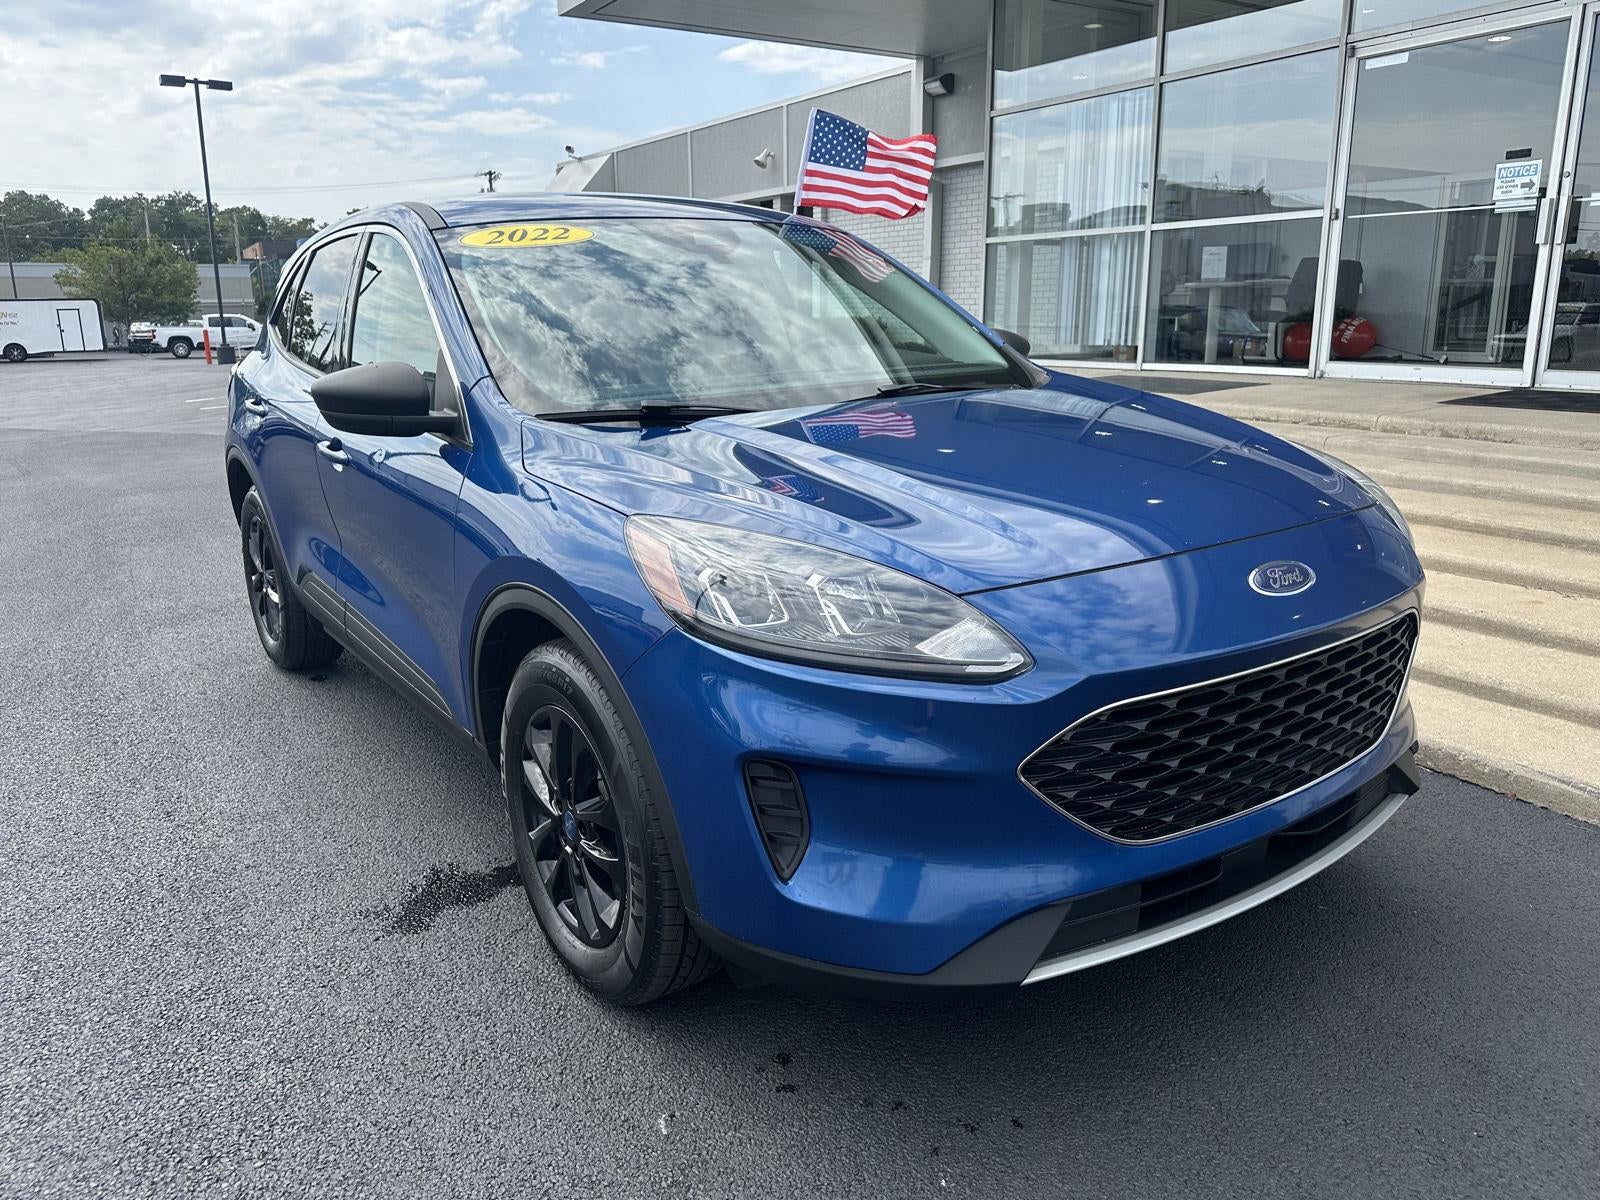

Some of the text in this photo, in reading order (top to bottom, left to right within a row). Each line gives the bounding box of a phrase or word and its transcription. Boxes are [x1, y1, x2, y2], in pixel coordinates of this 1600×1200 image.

[1499, 164, 1538, 178] NOTICE
[484, 227, 571, 245] 2022
[1266, 565, 1303, 588] Ford
